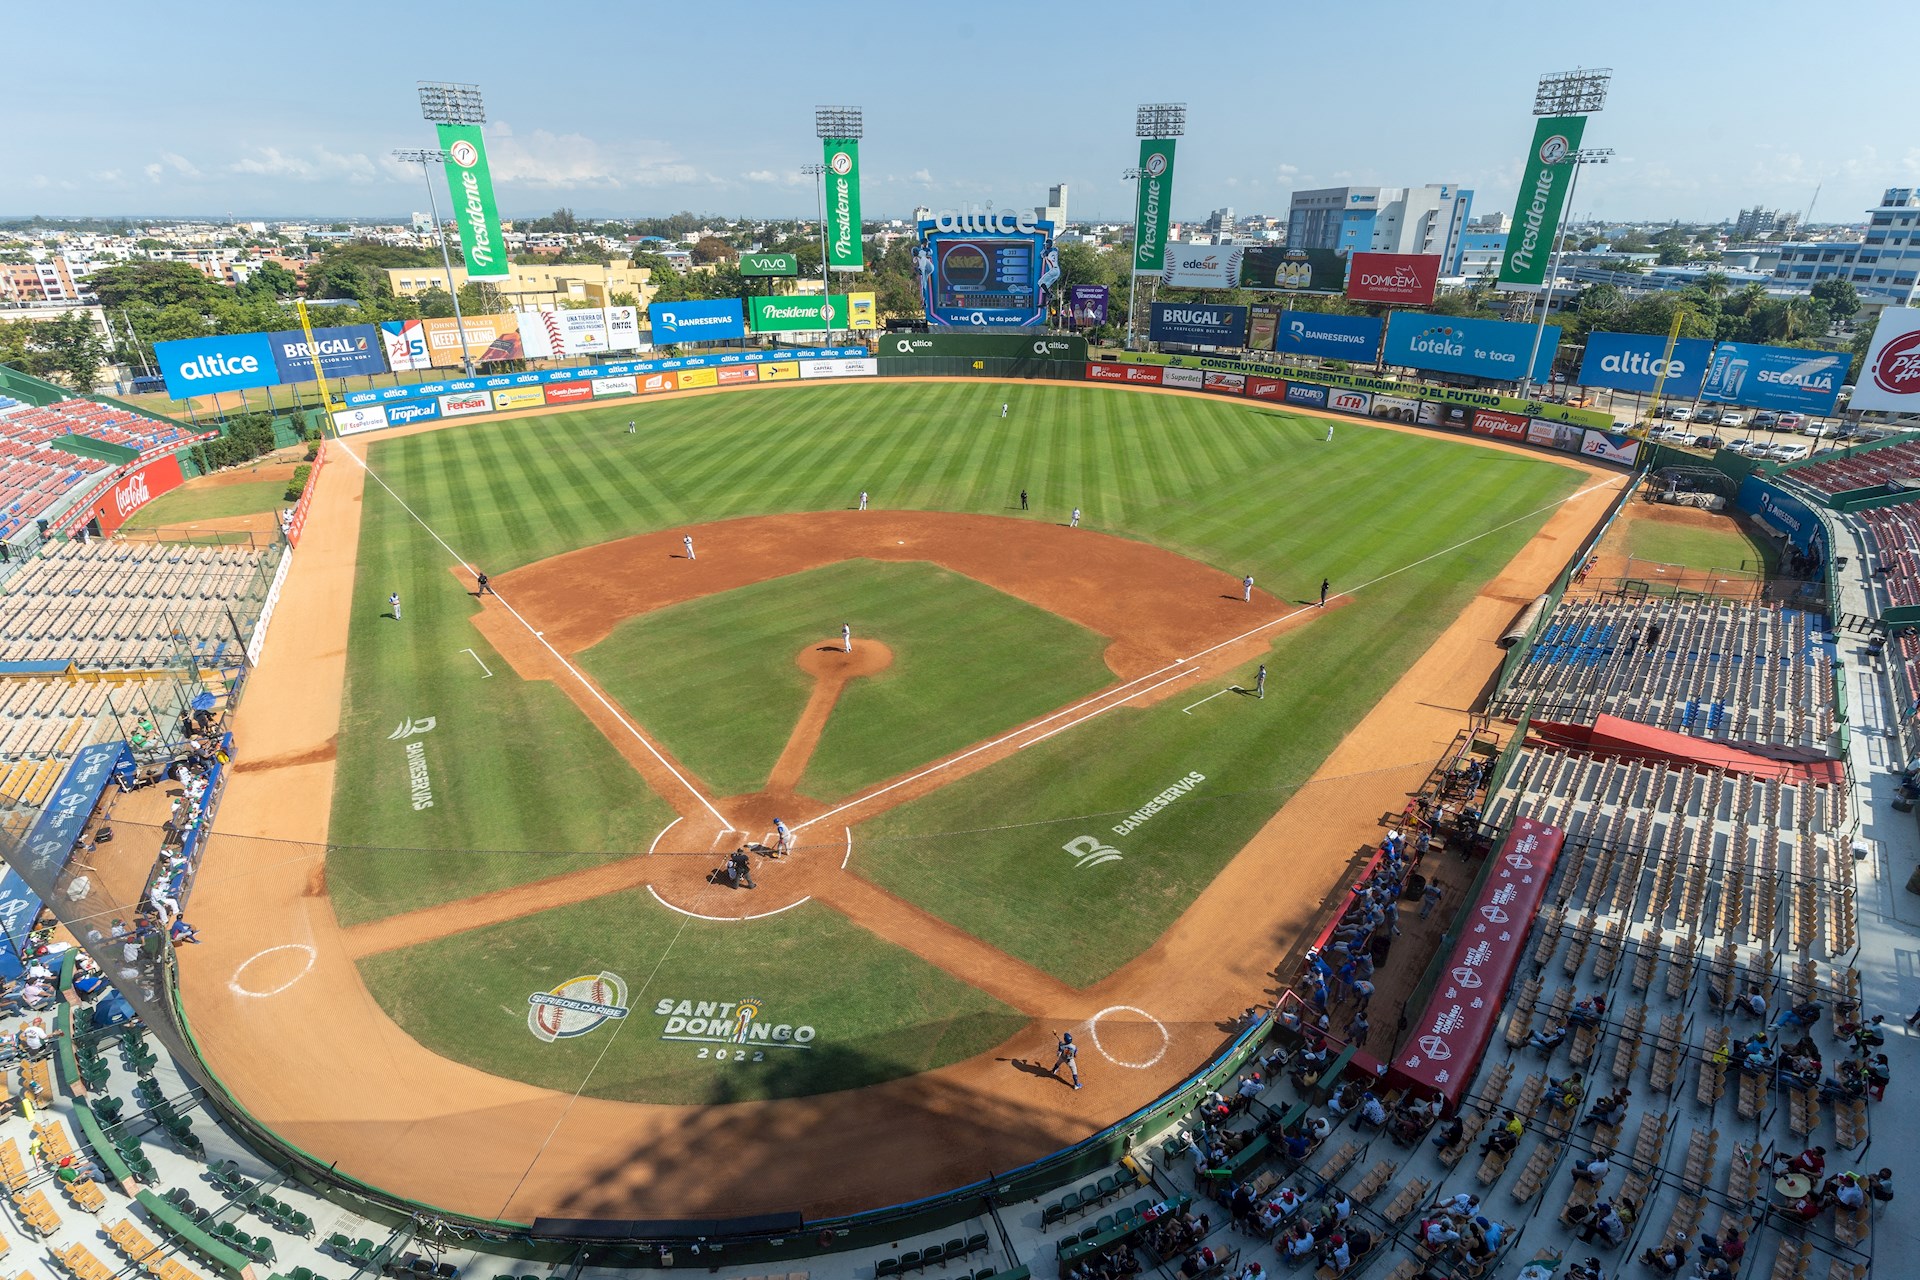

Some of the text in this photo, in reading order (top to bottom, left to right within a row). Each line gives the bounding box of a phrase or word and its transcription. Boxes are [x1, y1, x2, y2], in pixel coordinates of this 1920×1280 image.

[462, 172, 494, 267] Presidente
[836, 178, 851, 259] Presidente
[936, 200, 1038, 234] altice
[1139, 180, 1161, 262] Presidente
[1511, 169, 1553, 274] Presidente
[1183, 259, 1219, 269] edesur
[1361, 273, 1415, 287] DOMICEM
[762, 304, 819, 319] Presidente
[1163, 309, 1220, 325] BRUGAL
[464, 319, 493, 327] WALKER
[678, 315, 733, 327] BANRESERVAS
[1004, 315, 1022, 323] poder
[433, 333, 454, 346] KEEP
[912, 339, 933, 347] altice
[1305, 330, 1365, 344] BANRESERVAS
[283, 338, 355, 359] BRUGAL
[401, 339, 423, 358] JS
[844, 348, 862, 356] altice
[1048, 342, 1069, 350] altice
[1410, 336, 1515, 363] Loteka te toca
[745, 353, 763, 361] altice
[180, 352, 259, 381] altice
[608, 366, 628, 374] altice
[634, 363, 653, 371] altice
[663, 360, 681, 368] altice
[972, 361, 984, 369] 411
[1600, 351, 1685, 379] altice
[517, 374, 539, 382] altice
[550, 371, 571, 379] altice
[578, 368, 598, 376] altice
[1171, 373, 1201, 383] SuperBets
[451, 381, 475, 391] altice
[487, 377, 510, 386] altice
[1200, 358, 1500, 406] CONSTRUYENDO EL PRESENTE, IMAGINANDO EL FUTURO
[384, 389, 408, 398] altice
[420, 384, 443, 394] altice
[352, 393, 376, 402] altice
[1336, 395, 1362, 409] LTH
[447, 399, 486, 411] Fersan
[388, 402, 436, 422] Tropical
[1475, 413, 1527, 433] Tropical
[1590, 441, 1608, 454] JS
[406, 741, 434, 811] BANRESERVAS
[1112, 771, 1206, 836] BANRESERVAS
[698, 1048, 765, 1062] 2022
